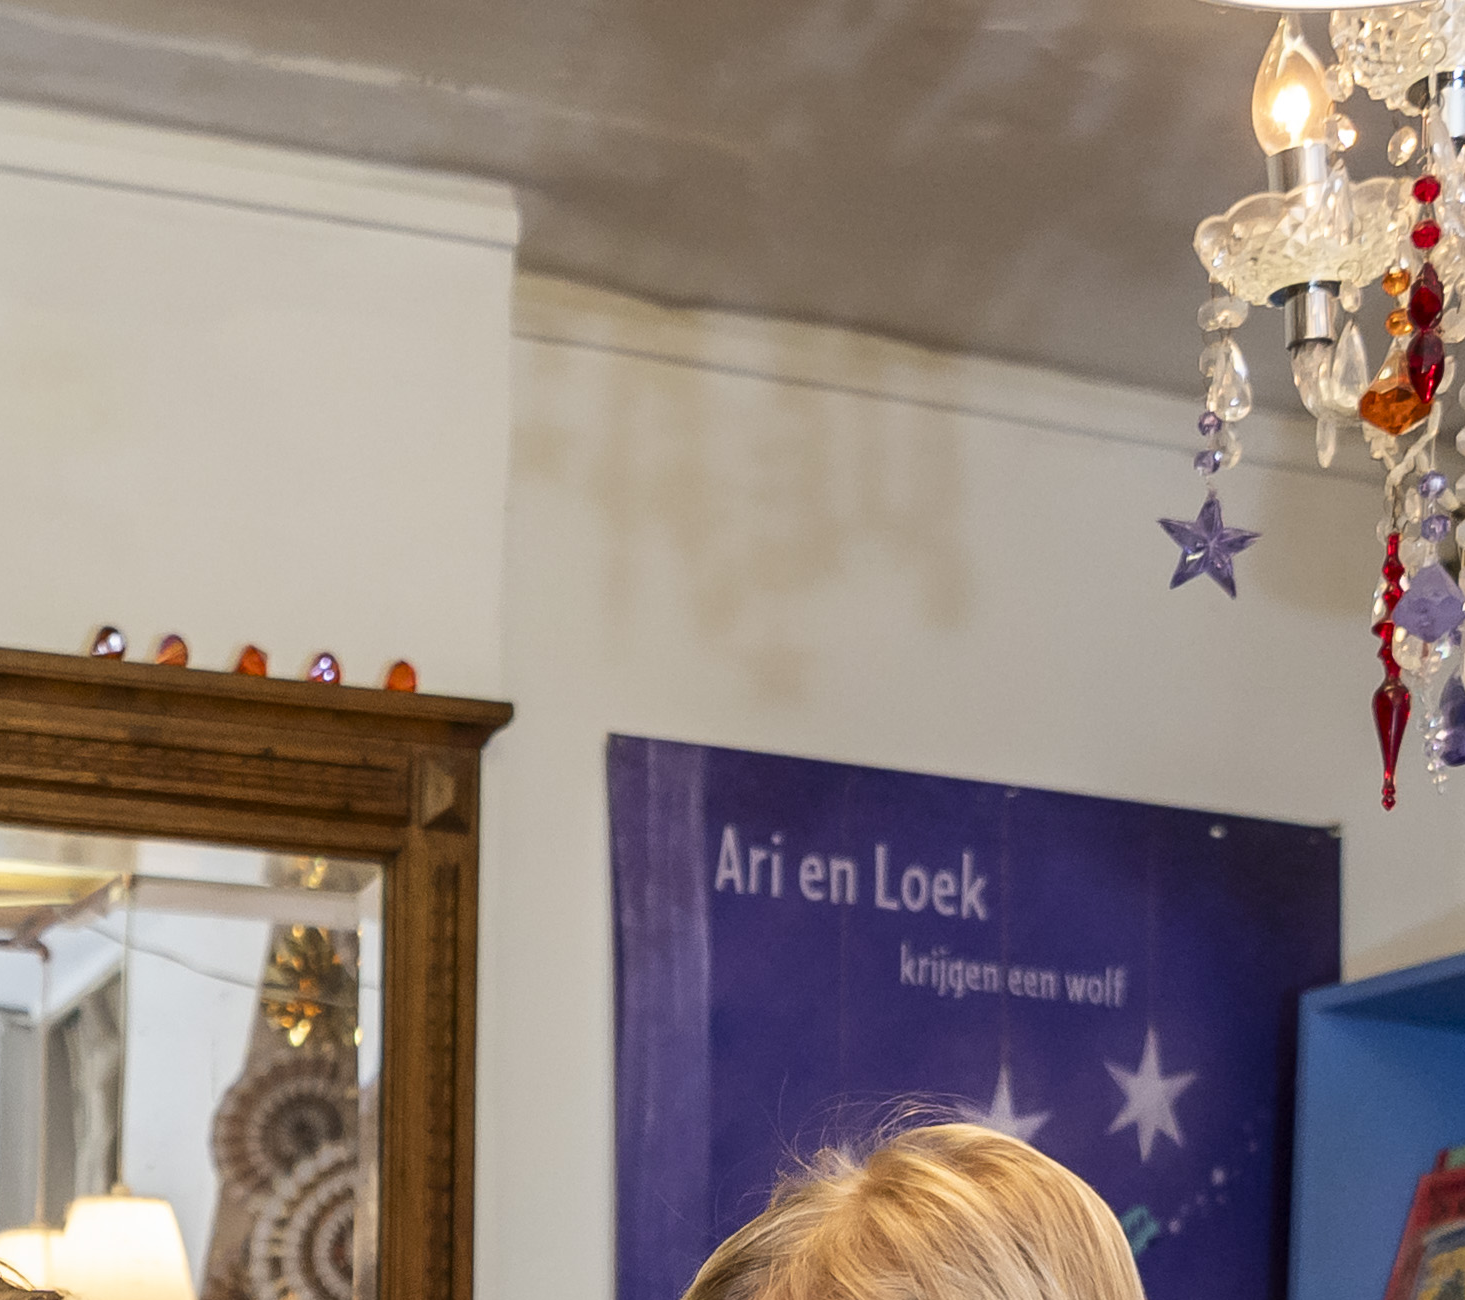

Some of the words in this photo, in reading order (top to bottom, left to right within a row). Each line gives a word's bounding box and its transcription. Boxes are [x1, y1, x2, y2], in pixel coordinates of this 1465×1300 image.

[714, 823, 785, 898] Ari
[798, 856, 859, 906] en
[874, 842, 990, 921] Loek
[898, 942, 1002, 998] krijgen
[1007, 963, 1057, 1001] een
[1065, 963, 1127, 1008] wolf
